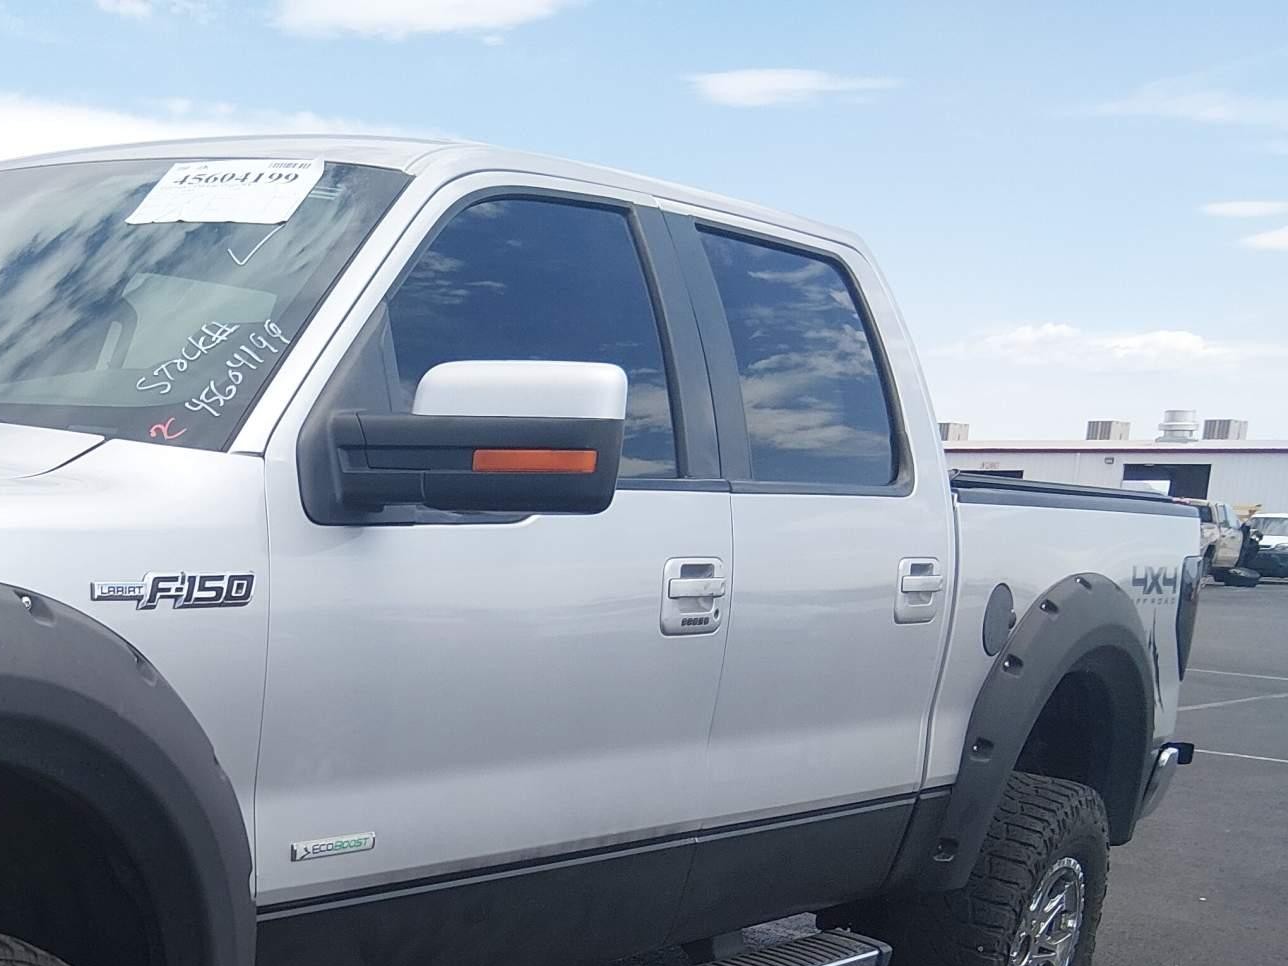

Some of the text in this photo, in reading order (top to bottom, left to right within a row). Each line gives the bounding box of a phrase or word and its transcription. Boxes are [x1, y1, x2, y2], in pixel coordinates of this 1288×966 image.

[173, 171, 299, 186] 45604199
[185, 319, 291, 417] 45604199
[99, 571, 256, 607] LARIAT F-150
[1132, 565, 1177, 594] 4X4
[311, 835, 370, 855] ECOBOOST
